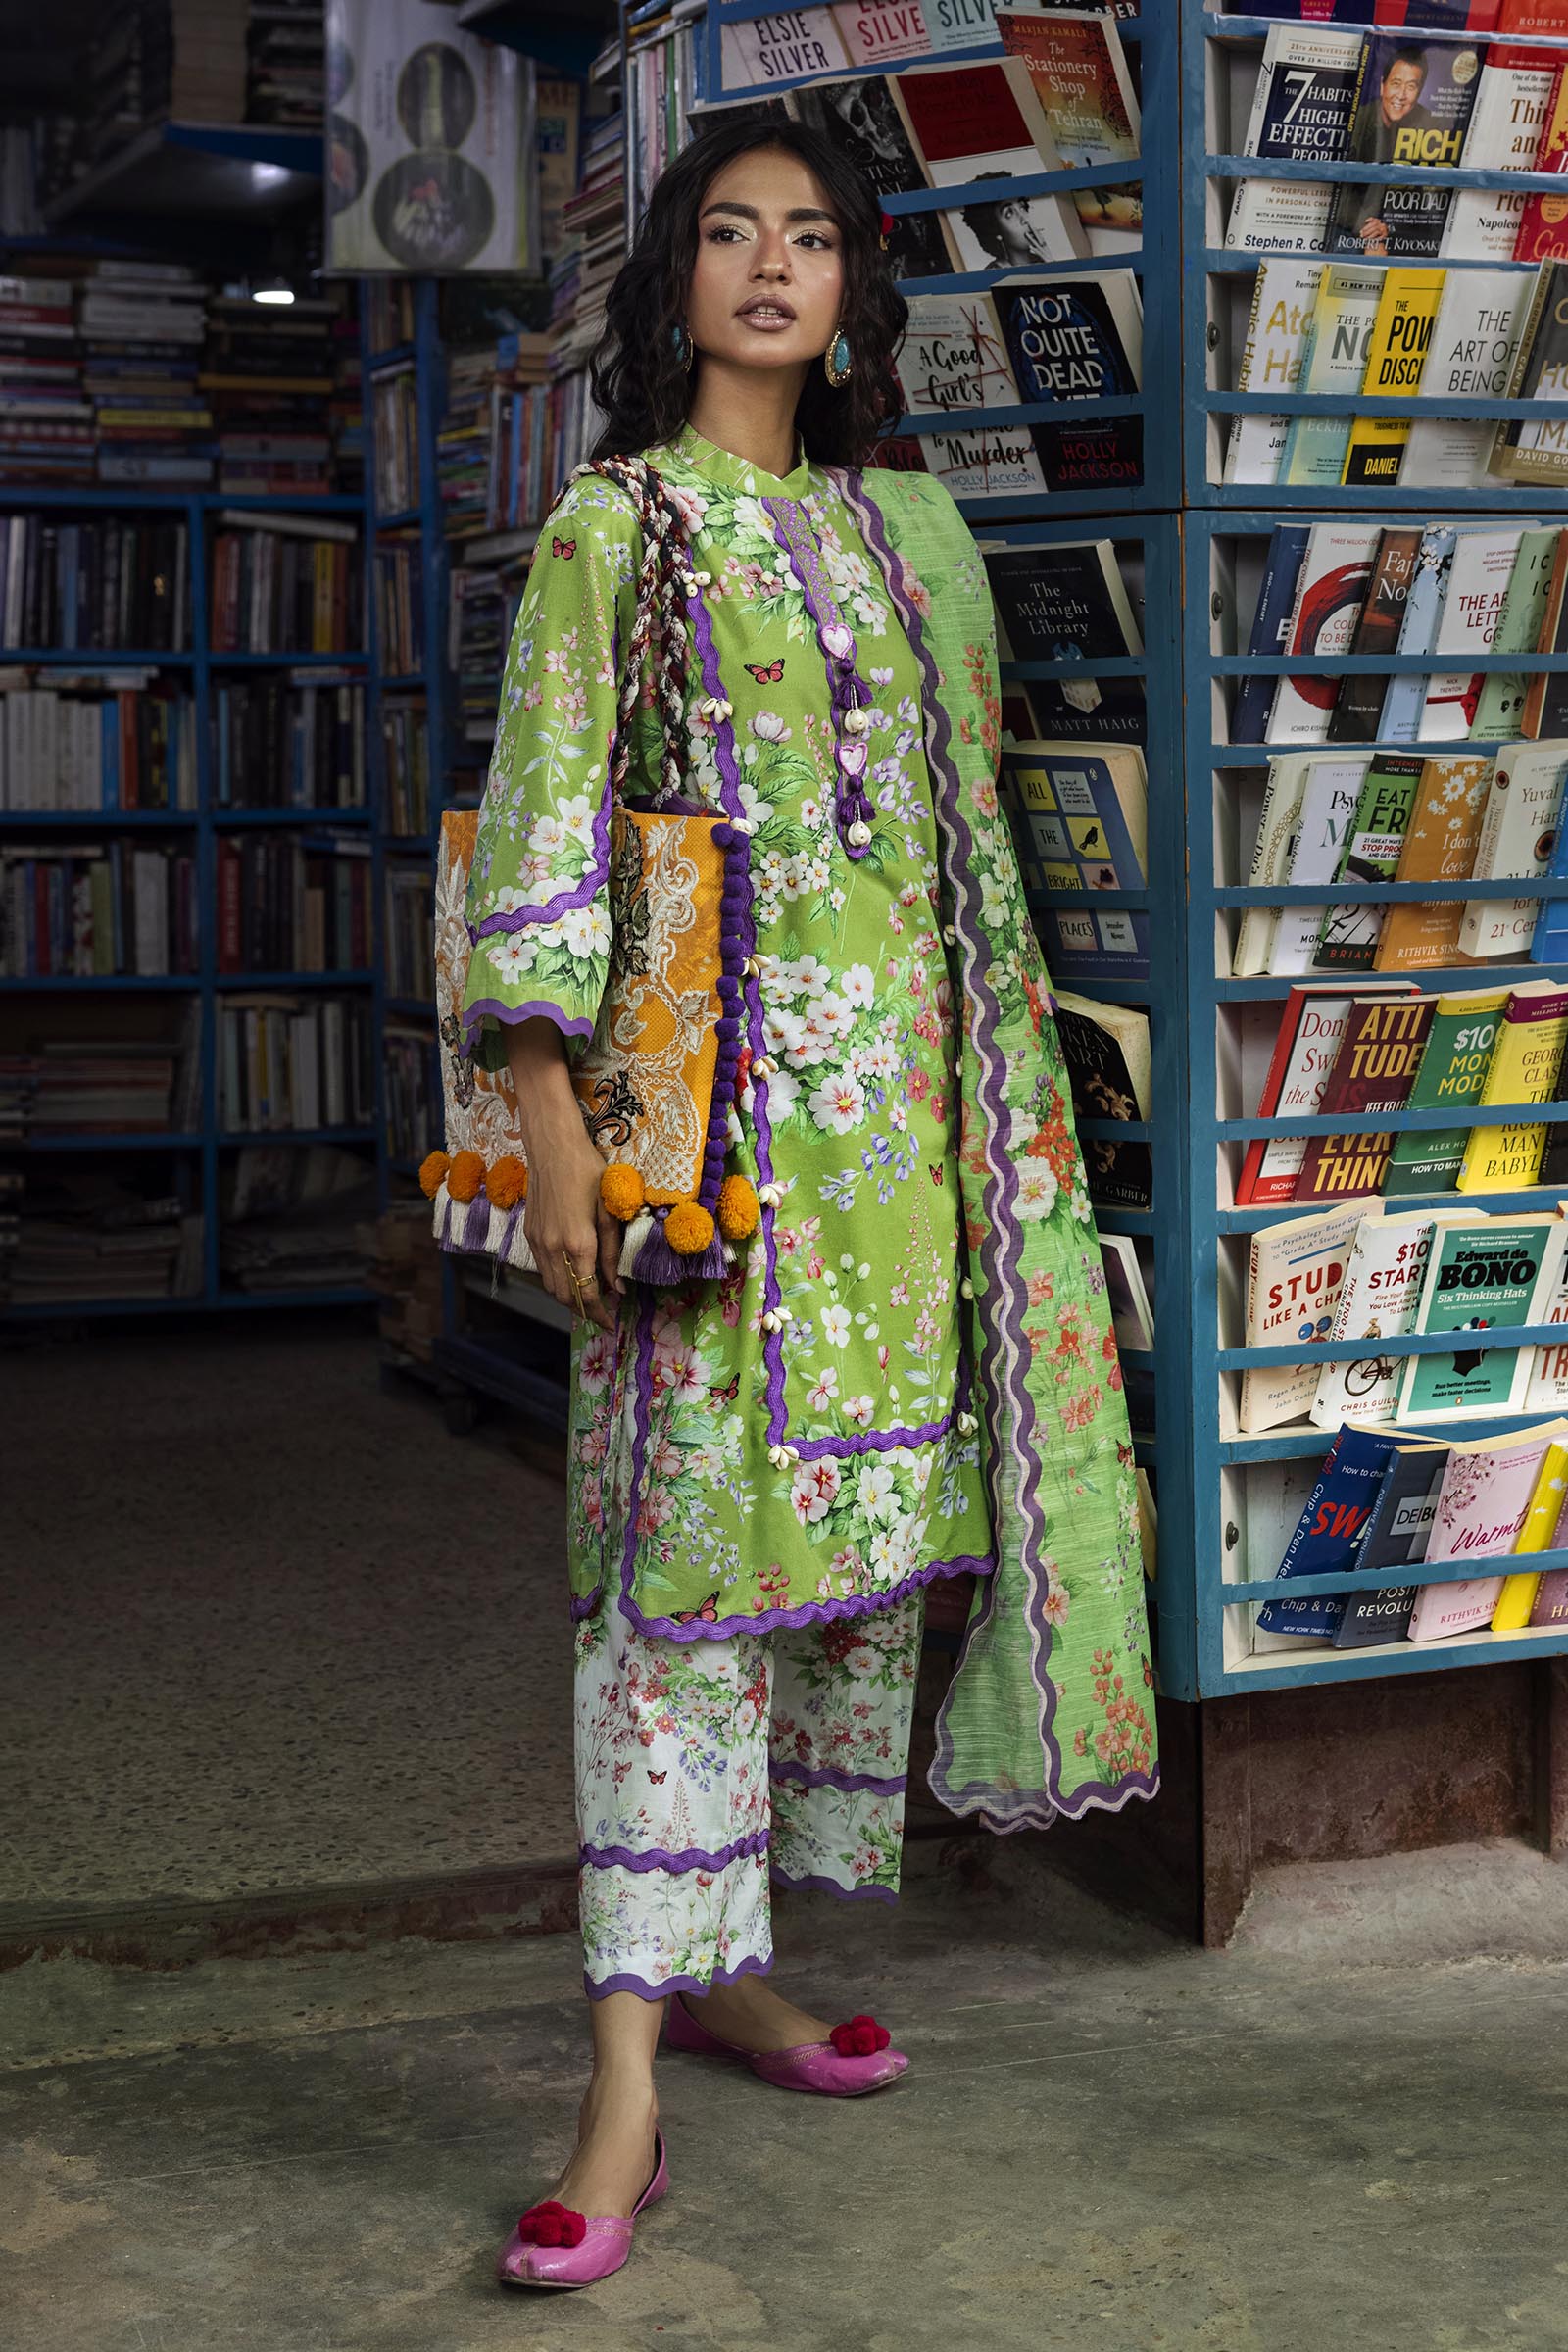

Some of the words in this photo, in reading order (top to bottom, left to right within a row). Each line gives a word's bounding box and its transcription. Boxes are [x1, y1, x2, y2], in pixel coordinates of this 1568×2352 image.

[754, 12, 810, 45] ELSIE
[858, 6, 926, 48] SILVE
[1014, 24, 1049, 36] MARJAN
[1052, 26, 1087, 37] KAMALI
[1519, 17, 1567, 28] ROBERT
[1048, 42, 1066, 56] The
[760, 42, 830, 77] SILVER
[1025, 54, 1098, 80] Stationery
[1317, 57, 1342, 66] MILLION
[1049, 75, 1086, 100] Shop
[1282, 70, 1317, 123] 7
[1067, 99, 1077, 112] of
[1049, 109, 1103, 129] Tehran
[1393, 127, 1463, 161] RICH
[1271, 186, 1312, 197] POWERFUL
[1275, 198, 1311, 208] PERSONAL
[1383, 192, 1421, 211] POOR
[1422, 193, 1449, 212] DAD
[1244, 235, 1293, 252] Stephen
[1296, 237, 1306, 250] R.
[1338, 234, 1381, 250] ROBERT
[1383, 237, 1392, 250] T.
[1307, 269, 1323, 279] Tiny
[1248, 263, 1268, 334] Atomic
[1395, 300, 1409, 313] THE
[1019, 293, 1072, 325] NOT
[1336, 315, 1359, 325] THE
[1477, 310, 1512, 332] THE
[1020, 326, 1100, 358] QUITE
[1449, 339, 1488, 363] ART
[932, 337, 985, 375] Good
[1032, 360, 1105, 390] DEAD
[1448, 369, 1507, 393] BEING
[927, 372, 984, 411] Girl's
[1269, 419, 1283, 428] and
[947, 437, 1027, 468] Murder
[1062, 441, 1118, 461] HOLLY
[1516, 449, 1550, 463] DAVID
[1058, 461, 1138, 481] JACKSON
[1364, 457, 1398, 476] DANIEL
[950, 476, 985, 486] HOLLY
[988, 472, 1036, 485] JACKSON
[1029, 581, 1061, 599] The
[1017, 599, 1090, 619] Midnight
[1459, 593, 1488, 612] THE
[1029, 620, 1089, 637] Library
[1319, 633, 1333, 644] TO
[1334, 633, 1345, 644] BE
[1051, 719, 1091, 732] MATT
[1098, 717, 1139, 730] HAIG
[1291, 724, 1309, 733] ICHIRO
[1028, 782, 1048, 800] ALL
[1376, 787, 1411, 805] EAT
[1521, 782, 1559, 804] Yuval
[1260, 785, 1275, 830] Power
[1367, 806, 1407, 834] FR
[1038, 828, 1059, 846] THE
[1443, 835, 1449, 850] I
[1450, 832, 1481, 850] don't
[1361, 844, 1382, 853] STOP
[1440, 850, 1470, 875] love
[1048, 877, 1081, 891] BRIGHT
[1059, 920, 1095, 938] PLACES
[1329, 948, 1372, 960] BRIAN
[1397, 944, 1438, 958] RITHVIK
[1531, 1006, 1559, 1017] MILLION
[1301, 1012, 1344, 1039] Don
[1357, 1004, 1426, 1041] ATTI
[1349, 1042, 1425, 1079] TUDE
[1284, 1084, 1310, 1105] the
[1437, 1073, 1485, 1097] MOD
[1334, 1082, 1367, 1113] IS
[1427, 1142, 1450, 1152] ALEX
[1498, 1132, 1542, 1154] MAN
[1411, 1164, 1431, 1175] HOW
[1433, 1163, 1444, 1172] TO
[1485, 1154, 1540, 1177] BABYL
[1105, 1184, 1149, 1203] GARBER
[1348, 1211, 1368, 1224] Guide
[1319, 1233, 1340, 1246] Study
[1417, 1226, 1433, 1237] THE
[1396, 1239, 1430, 1264] $10
[1454, 1248, 1510, 1263] Edward
[1510, 1248, 1529, 1260] de
[1250, 1242, 1259, 1284] STUDY
[1436, 1258, 1537, 1291] BONO
[1339, 1283, 1349, 1307] CHRIS
[1348, 1277, 1358, 1298] THE
[1389, 1291, 1402, 1299] Your
[1437, 1294, 1453, 1304] Six
[1455, 1289, 1503, 1302] Thinking
[1503, 1289, 1528, 1298] Hats
[1263, 1308, 1293, 1331] LIKE
[1298, 1302, 1307, 1316] A
[1341, 1300, 1352, 1327] $100
[1268, 1386, 1291, 1401] Regan
[1275, 1399, 1292, 1409] John
[1340, 1401, 1368, 1413] CHRIS
[1342, 1465, 1359, 1476] How
[1360, 1468, 1369, 1477] to
[1307, 1483, 1324, 1512] Chip
[1372, 1488, 1386, 1525] POSITIVE
[1290, 1530, 1305, 1555] Dan
[1281, 1598, 1307, 1614] Chip
[1311, 1601, 1321, 1613] &
[1356, 1599, 1414, 1618] REVOLU
[1440, 1604, 1482, 1624] RITHVIK
